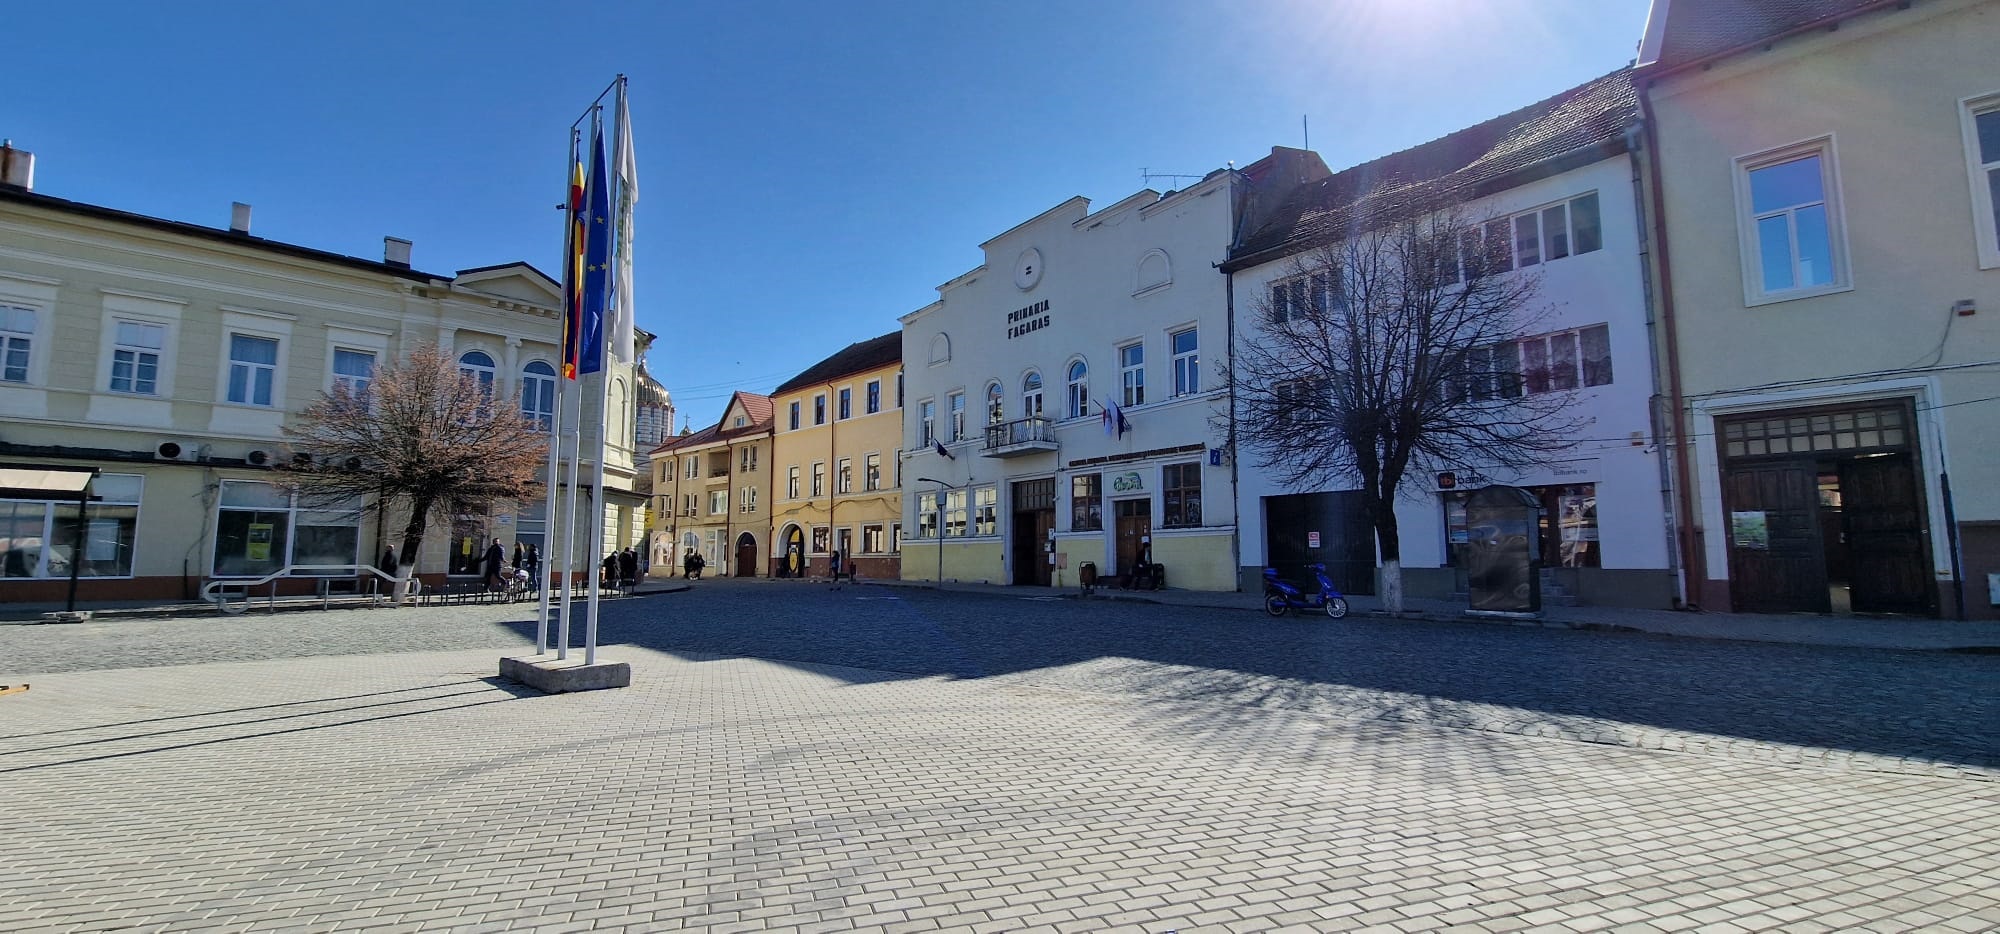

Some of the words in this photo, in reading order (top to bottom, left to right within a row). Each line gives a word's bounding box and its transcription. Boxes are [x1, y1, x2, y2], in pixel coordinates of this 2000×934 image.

[1008, 299, 1050, 324] PRIMARIA
[1008, 315, 1050, 340] FAGARAS
[1458, 475, 1488, 484] bank
